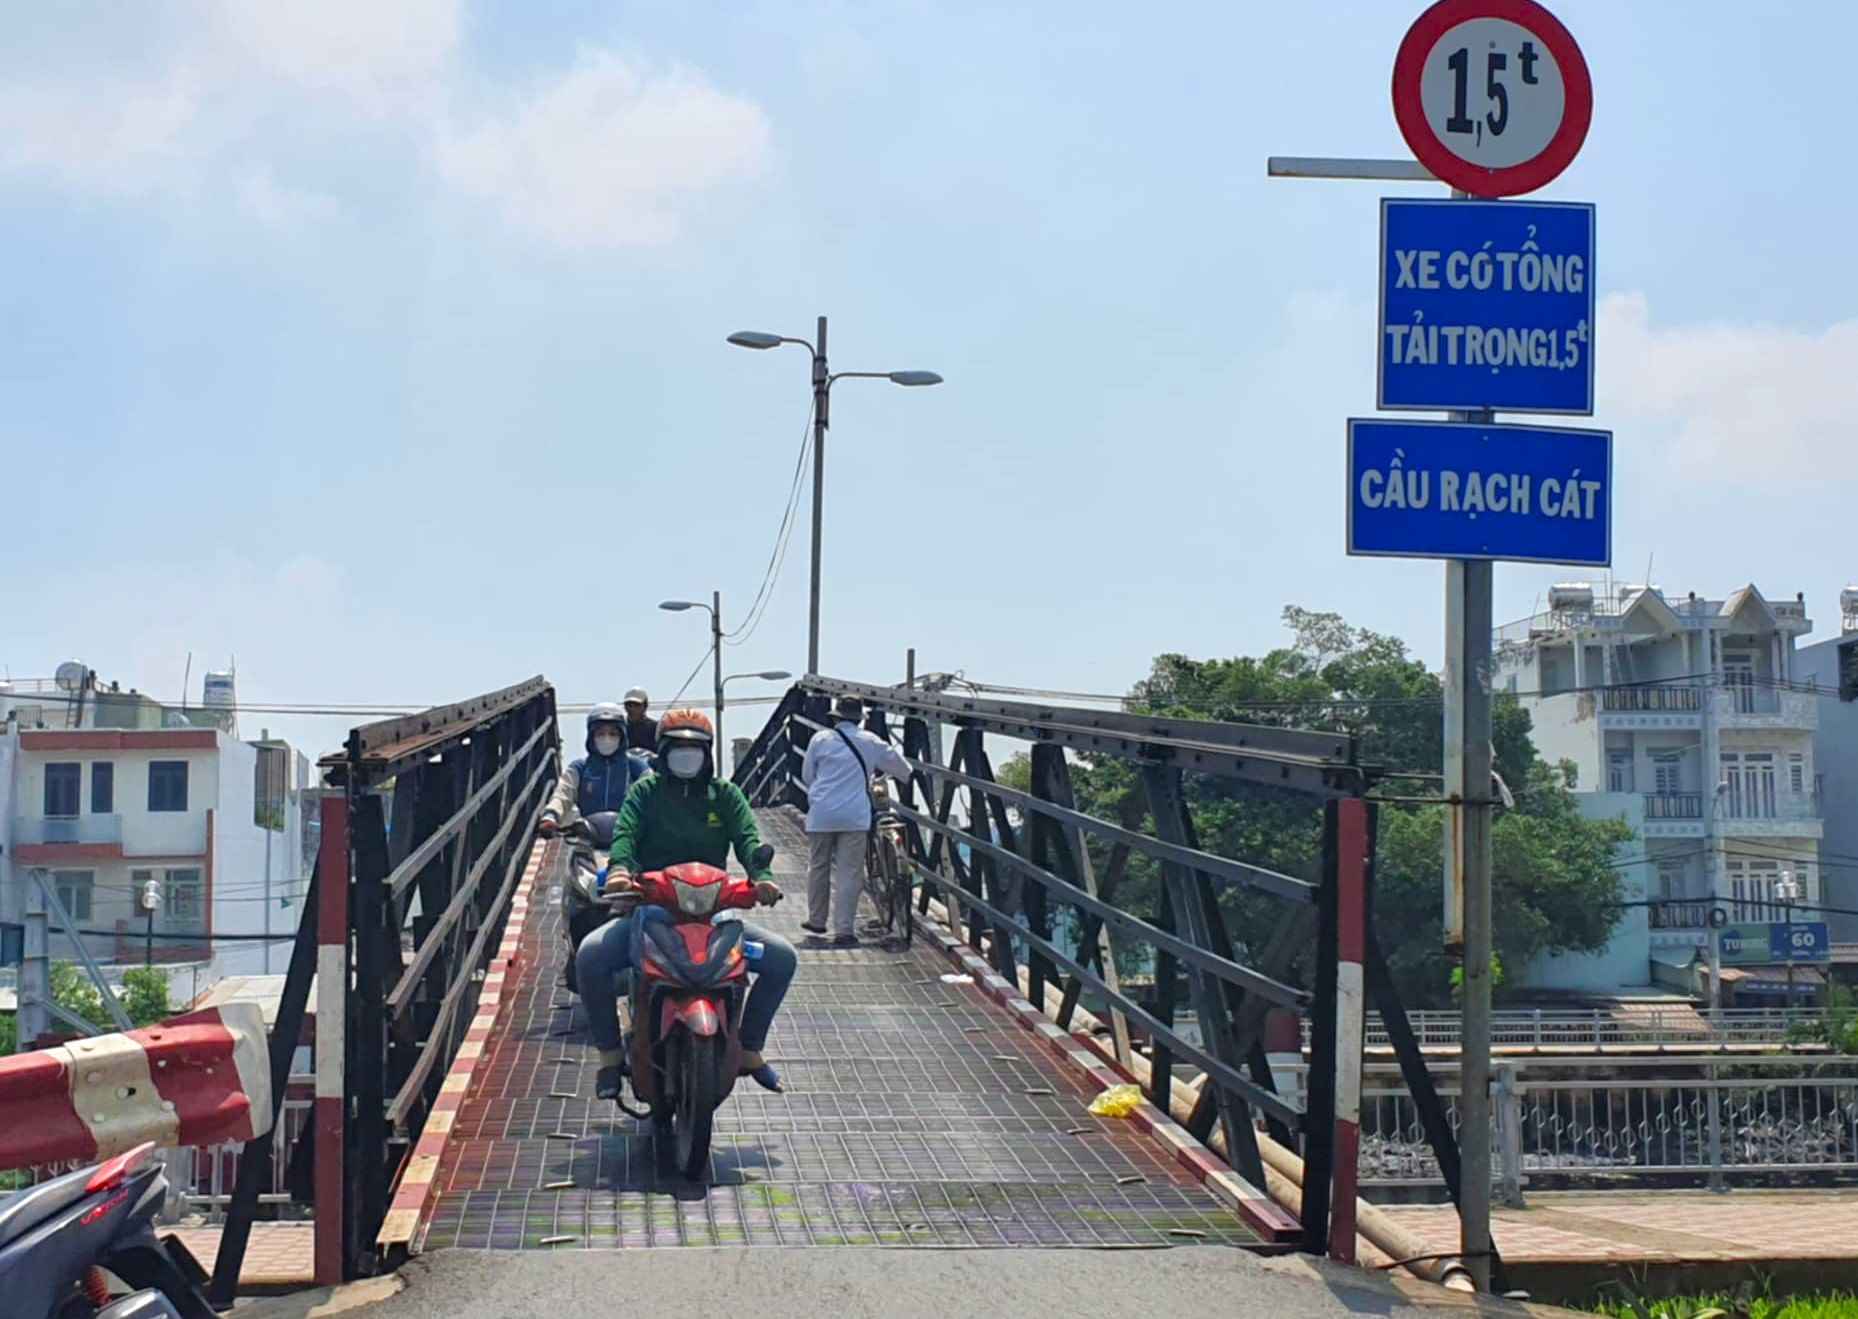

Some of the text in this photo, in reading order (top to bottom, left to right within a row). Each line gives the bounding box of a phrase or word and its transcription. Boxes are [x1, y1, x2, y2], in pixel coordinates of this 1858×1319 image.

[1394, 224, 1584, 293] XE CÓ TỔNG
[1386, 309, 1439, 365] TẢI
[1440, 324, 1548, 374] TRỌNG
[1360, 447, 1601, 520] CẦU RẠCH CÁT
